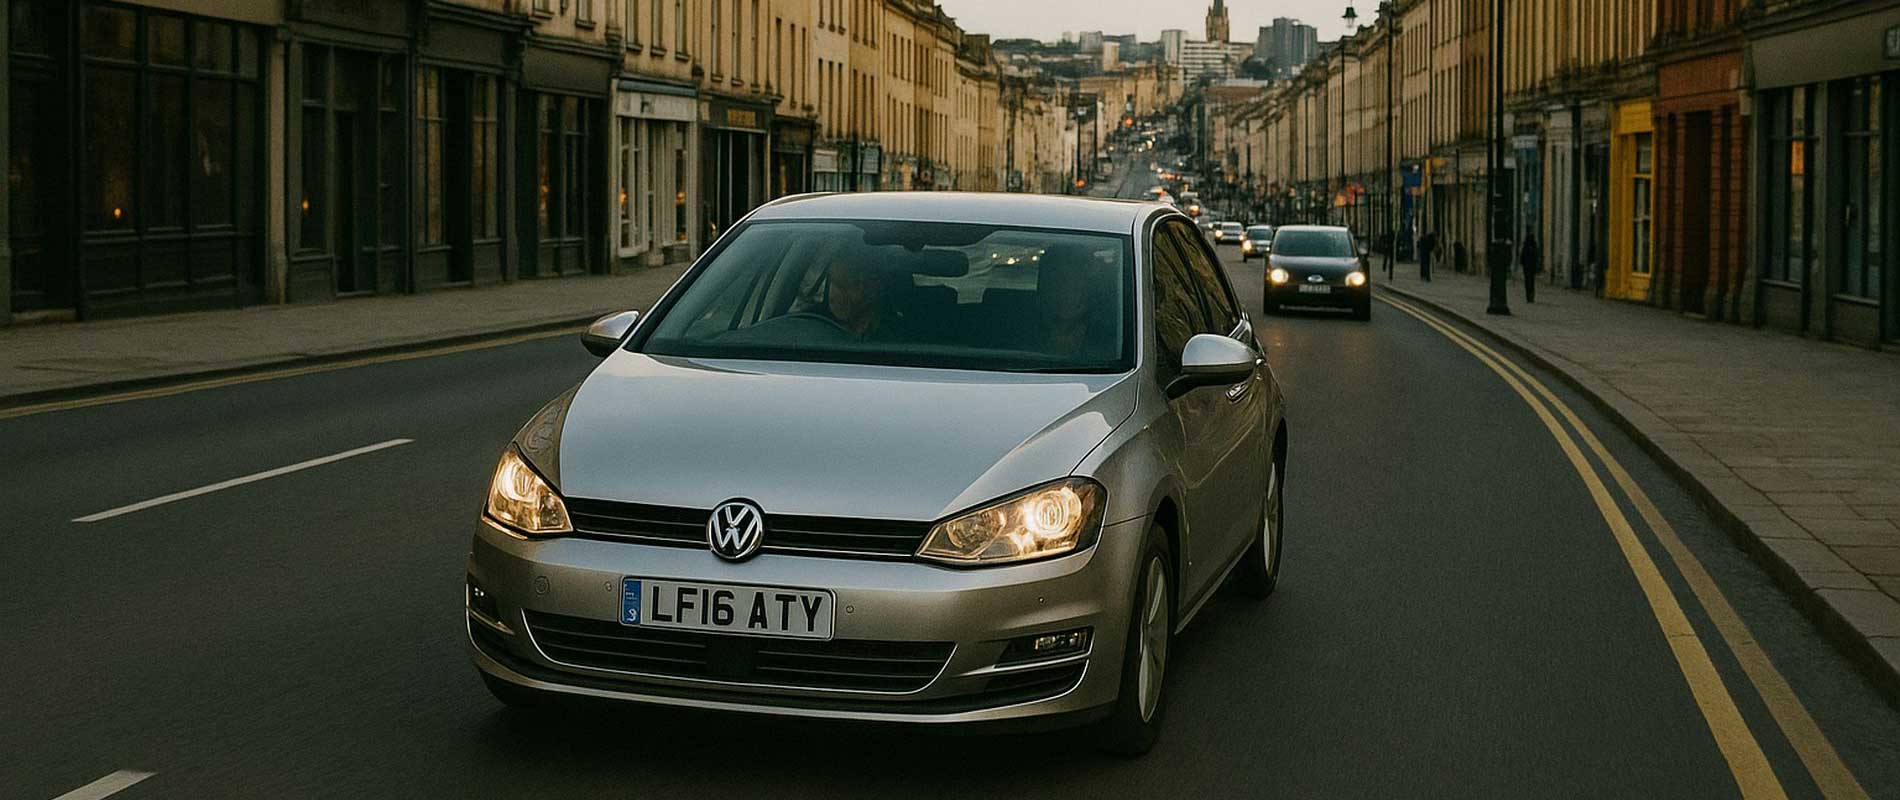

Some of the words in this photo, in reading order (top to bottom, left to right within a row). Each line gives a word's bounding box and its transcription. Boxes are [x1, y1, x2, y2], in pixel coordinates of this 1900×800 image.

[711, 504, 759, 551] VW
[651, 585, 735, 626] LF16
[747, 591, 823, 632] ATY
